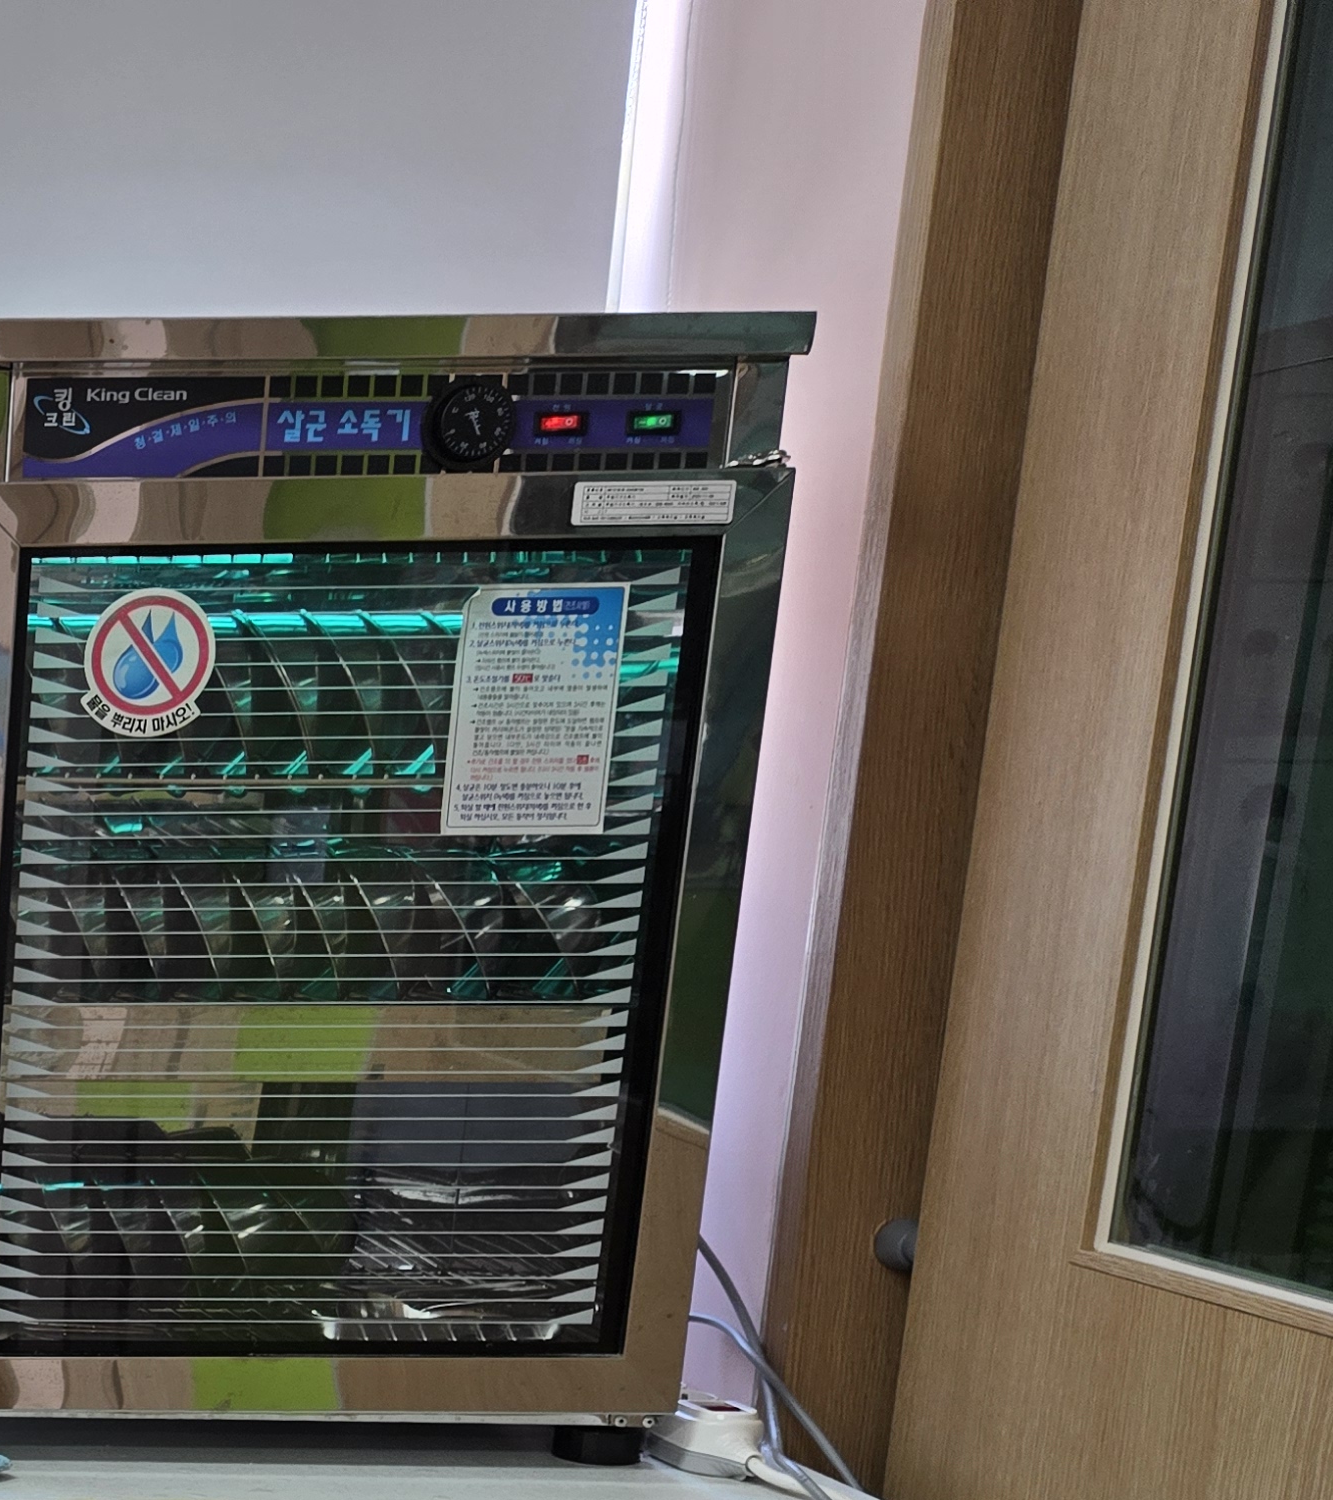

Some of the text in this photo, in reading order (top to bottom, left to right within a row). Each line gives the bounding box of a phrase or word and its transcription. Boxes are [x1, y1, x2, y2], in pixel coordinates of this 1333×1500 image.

[53, 387, 73, 412] 킹
[86, 387, 188, 404] King Clean
[44, 412, 76, 427] 크린
[337, 409, 411, 443] 소독기
[86, 694, 195, 734] 물을 뿌리지 마시오!
